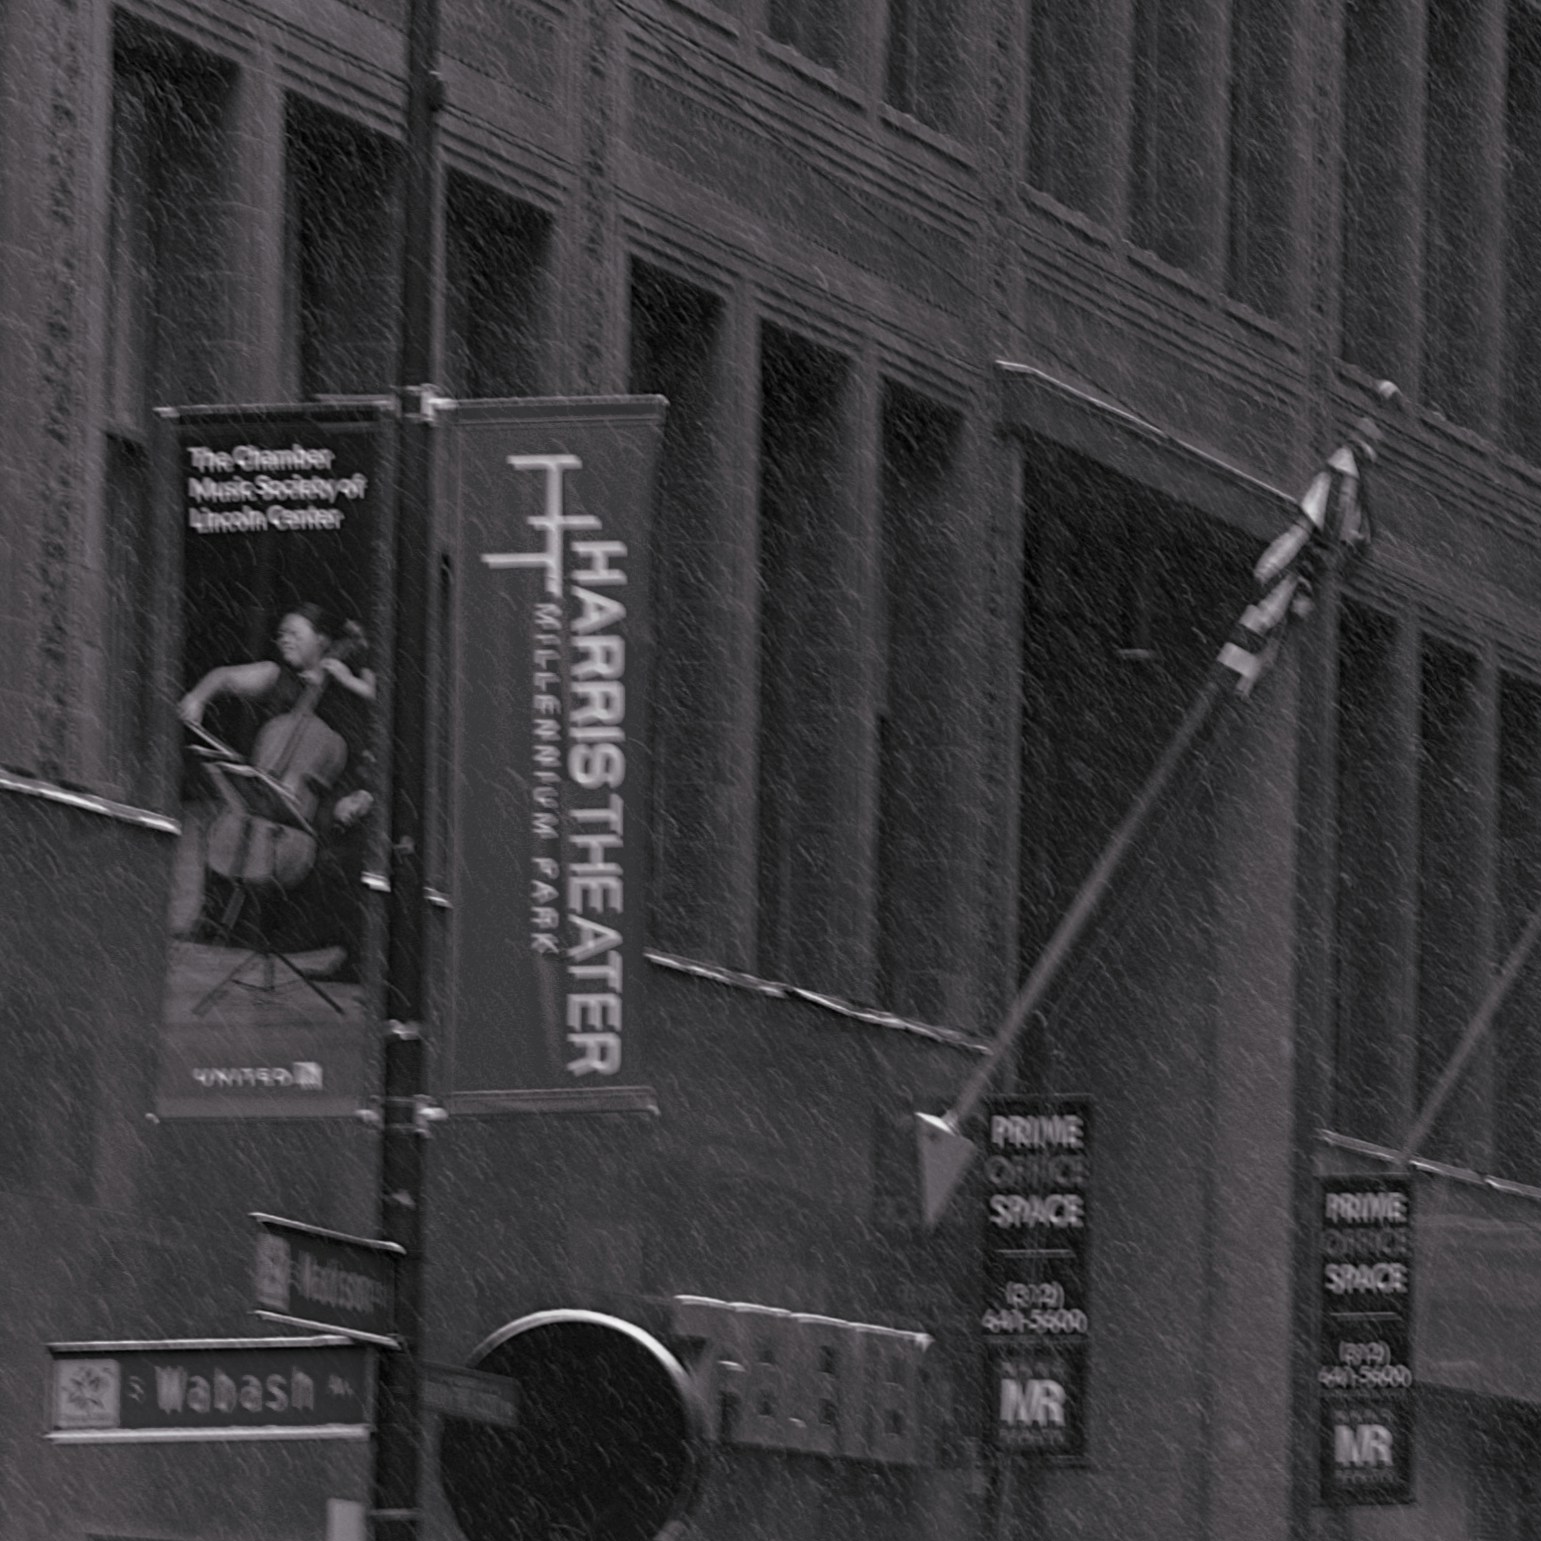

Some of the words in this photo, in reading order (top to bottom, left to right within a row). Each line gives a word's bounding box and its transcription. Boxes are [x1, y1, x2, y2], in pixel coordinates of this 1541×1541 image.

[187, 445, 235, 473] The
[233, 443, 336, 472] Chamber
[188, 475, 257, 502] Music
[254, 474, 337, 503] Society
[336, 472, 368, 499] of
[188, 505, 268, 534] Lincoln
[266, 504, 345, 531] Center
[569, 540, 628, 790] HARRIS
[532, 602, 563, 840] MILLENNIUM
[531, 857, 561, 956] PARK
[567, 803, 626, 1078] THEATER
[991, 1114, 1084, 1149] PRIME
[989, 1193, 1084, 1228] SPACE
[1325, 1191, 1408, 1222] PRIME
[1324, 1262, 1408, 1294] SPACE
[154, 1365, 316, 1415] Wabash
